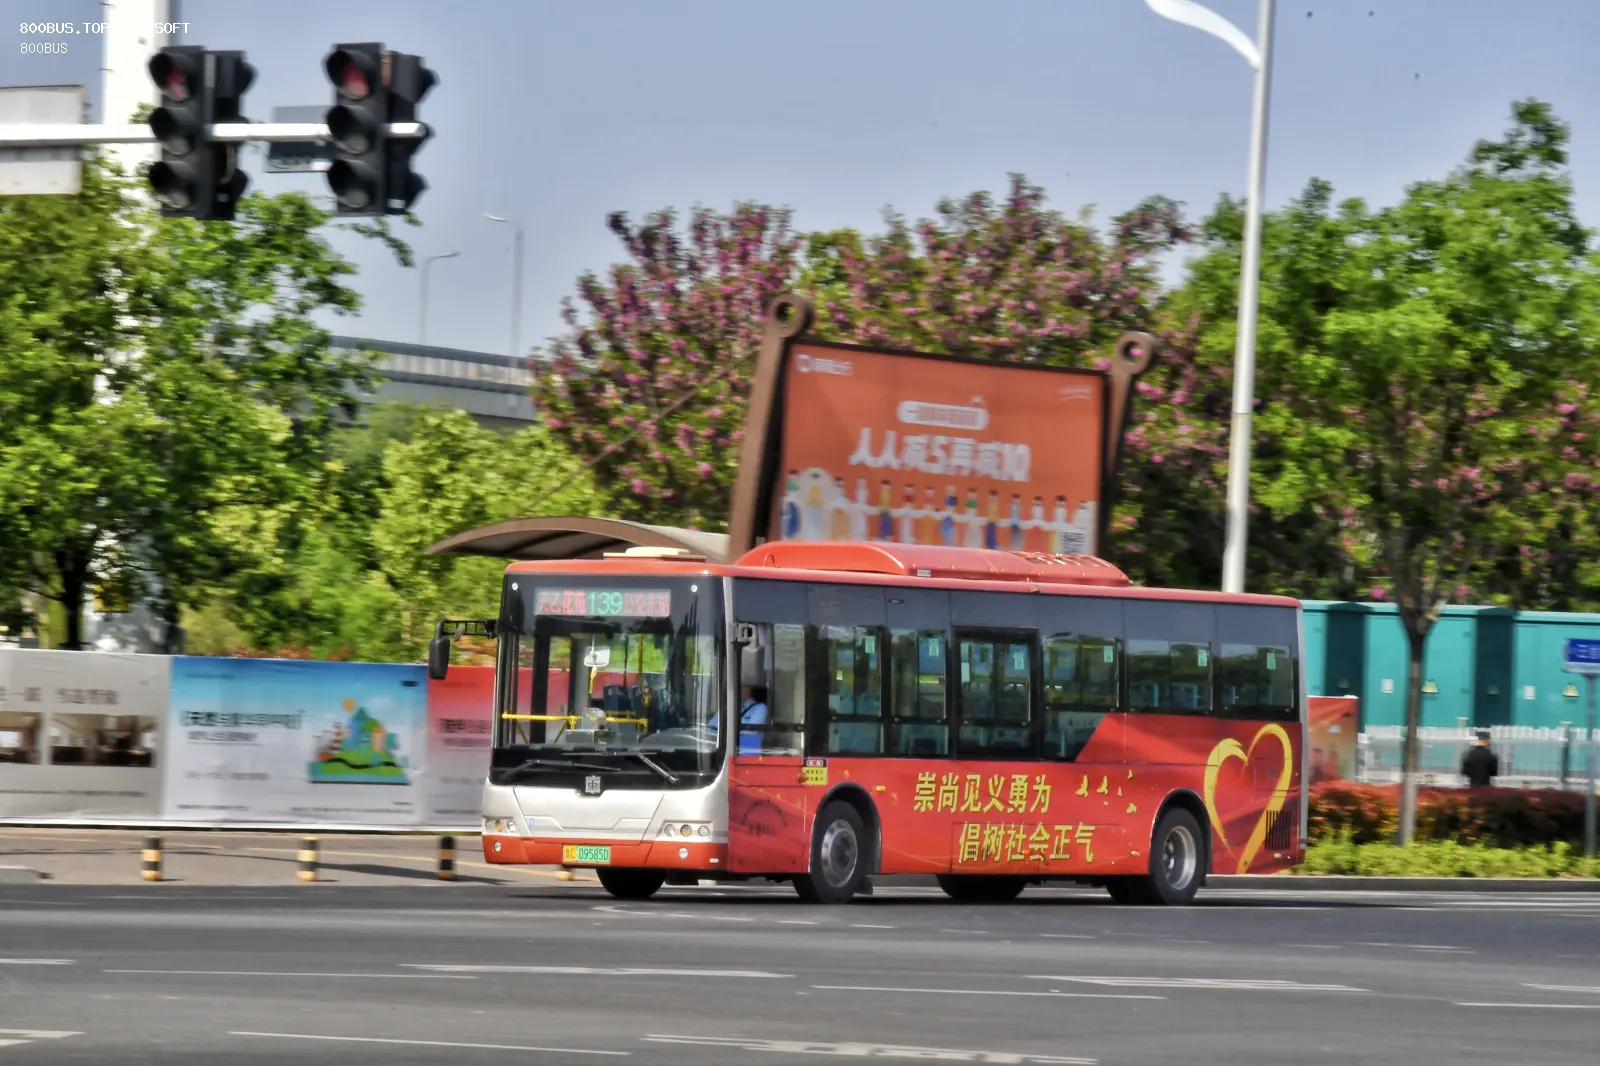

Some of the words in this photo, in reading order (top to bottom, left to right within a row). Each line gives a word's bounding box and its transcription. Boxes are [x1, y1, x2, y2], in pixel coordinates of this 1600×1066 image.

[587, 591, 623, 615] 139
[912, 771, 1053, 814] 崇尚见义勇为
[958, 820, 1097, 863] 倡树社会正气
